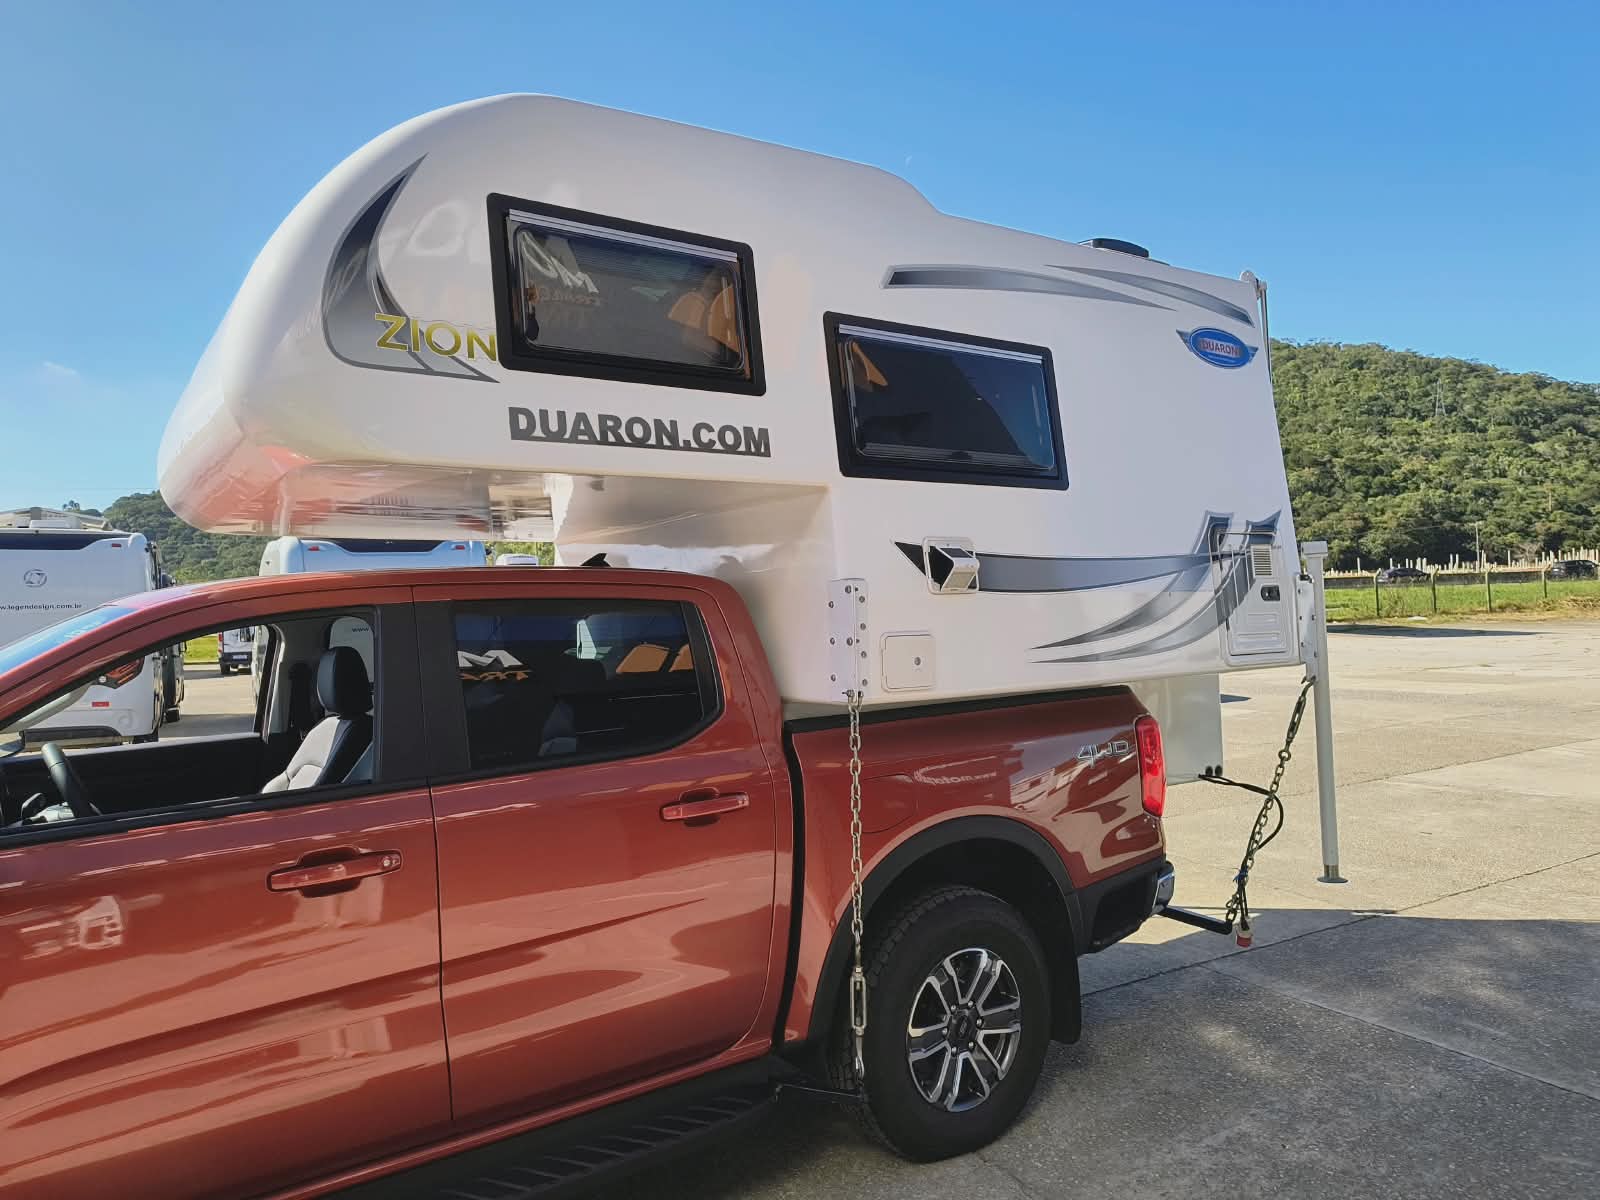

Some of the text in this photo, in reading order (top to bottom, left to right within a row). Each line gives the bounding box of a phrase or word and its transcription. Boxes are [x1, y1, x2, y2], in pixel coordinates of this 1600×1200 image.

[374, 312, 498, 362] ZION
[1202, 339, 1238, 356] DUARON
[508, 406, 771, 457] DUARON.COM
[1077, 740, 1129, 769] 4WD
